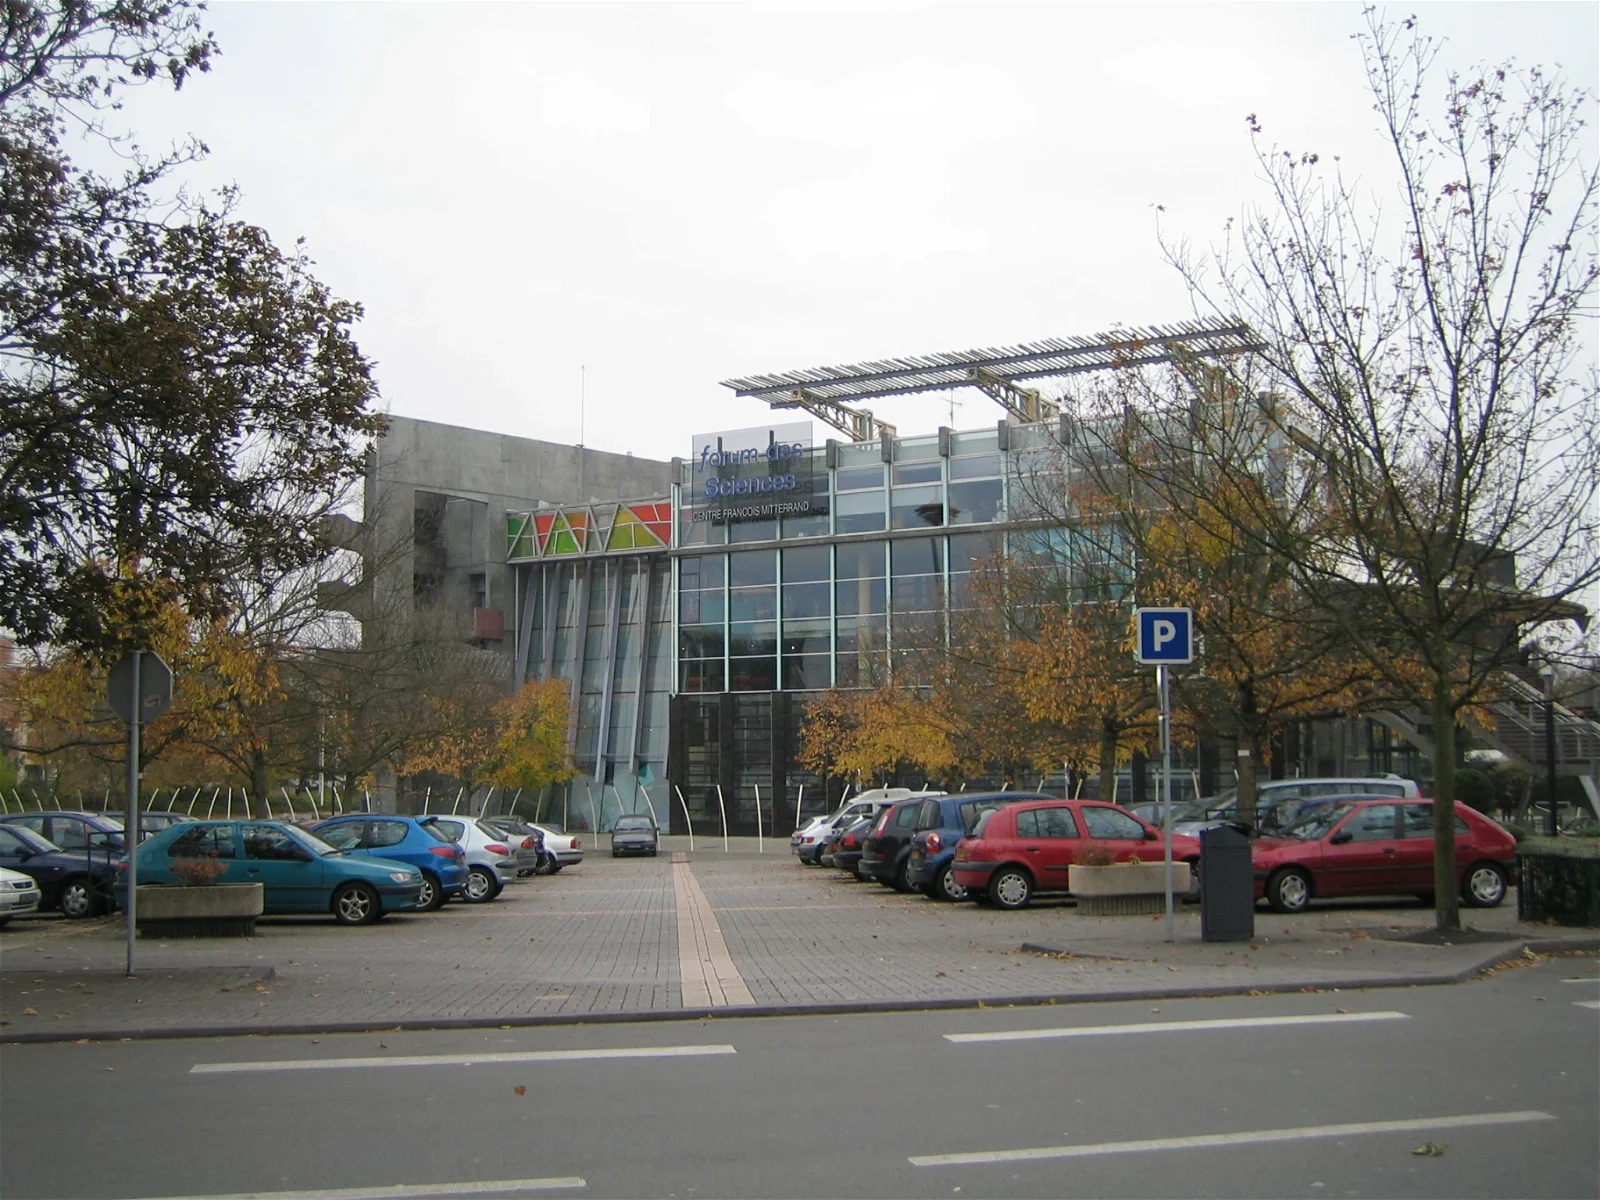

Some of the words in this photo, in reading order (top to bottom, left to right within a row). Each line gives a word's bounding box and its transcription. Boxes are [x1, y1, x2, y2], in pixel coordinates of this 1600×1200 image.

[698, 444, 758, 473] forum
[766, 440, 803, 462] des
[703, 473, 796, 499] Sciences
[693, 509, 722, 522] CENTRE
[761, 501, 809, 516] MITTERRAND
[1153, 620, 1176, 652] P
